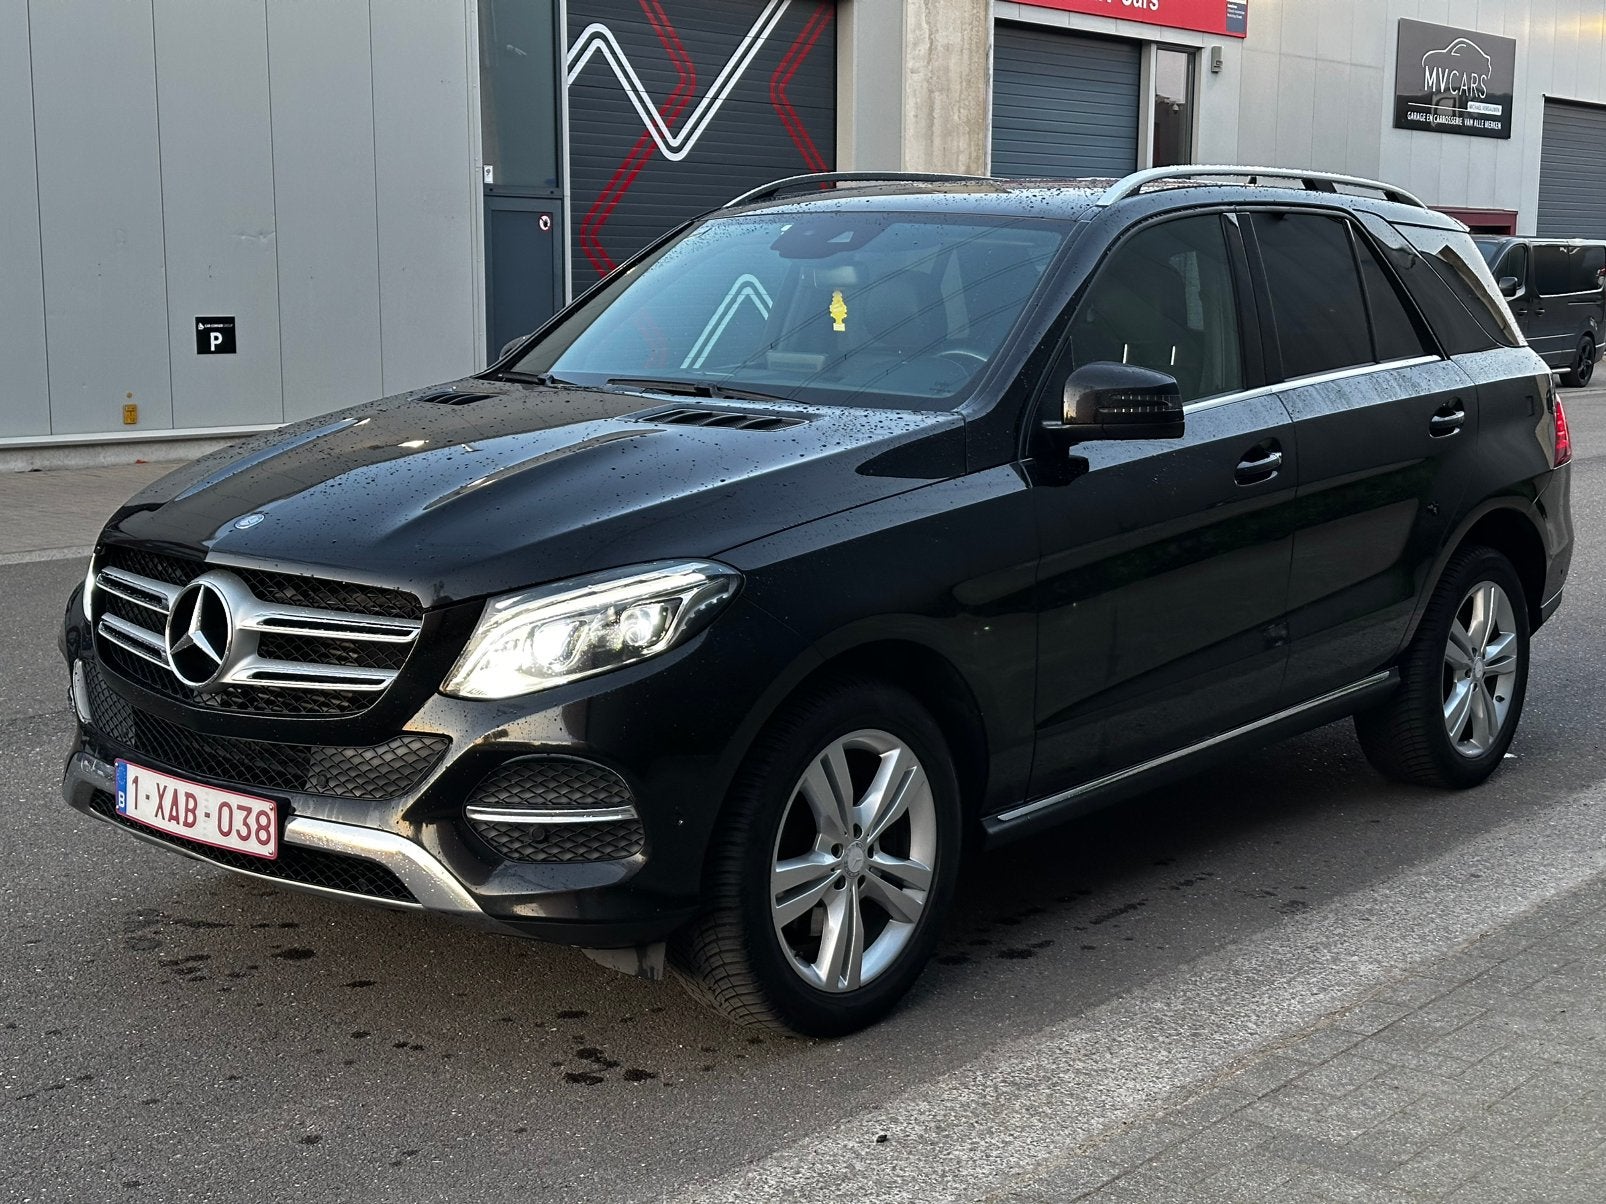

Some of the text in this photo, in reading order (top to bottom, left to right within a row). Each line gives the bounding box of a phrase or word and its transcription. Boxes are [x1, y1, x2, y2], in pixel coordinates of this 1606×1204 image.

[1424, 66, 1487, 99] MVCARS
[1407, 111, 1502, 130] GARAGE EN CARROSSERIE VAN ALLE MERKEN
[210, 331, 223, 351] P
[118, 791, 125, 808] B
[131, 775, 272, 847] 1-XAB-038
